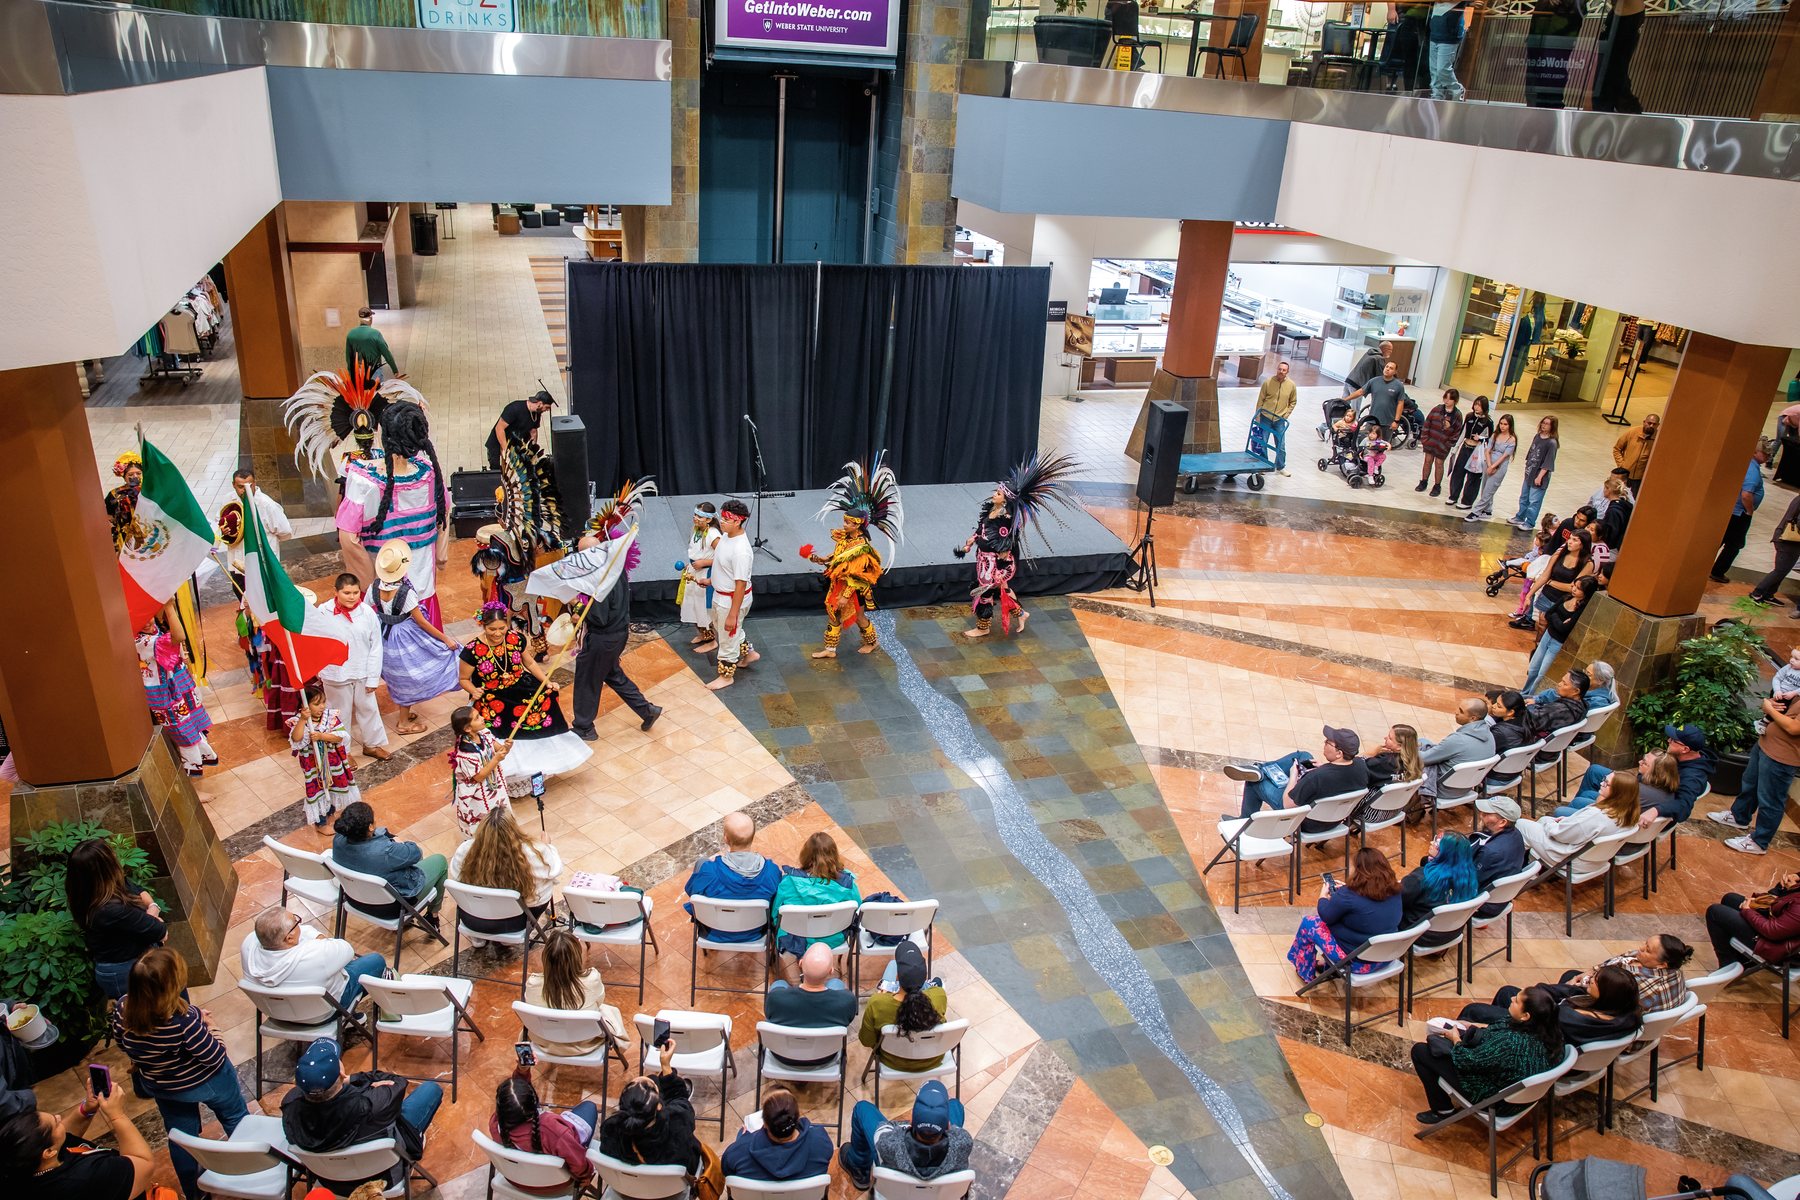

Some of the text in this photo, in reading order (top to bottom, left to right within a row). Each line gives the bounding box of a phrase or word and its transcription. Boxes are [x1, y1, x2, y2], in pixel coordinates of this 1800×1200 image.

[744, 0, 872, 22] GetIntoWeber.com
[775, 22, 796, 30] WEBER
[797, 23, 814, 32] STATE
[815, 25, 848, 34] UNIVERSITY
